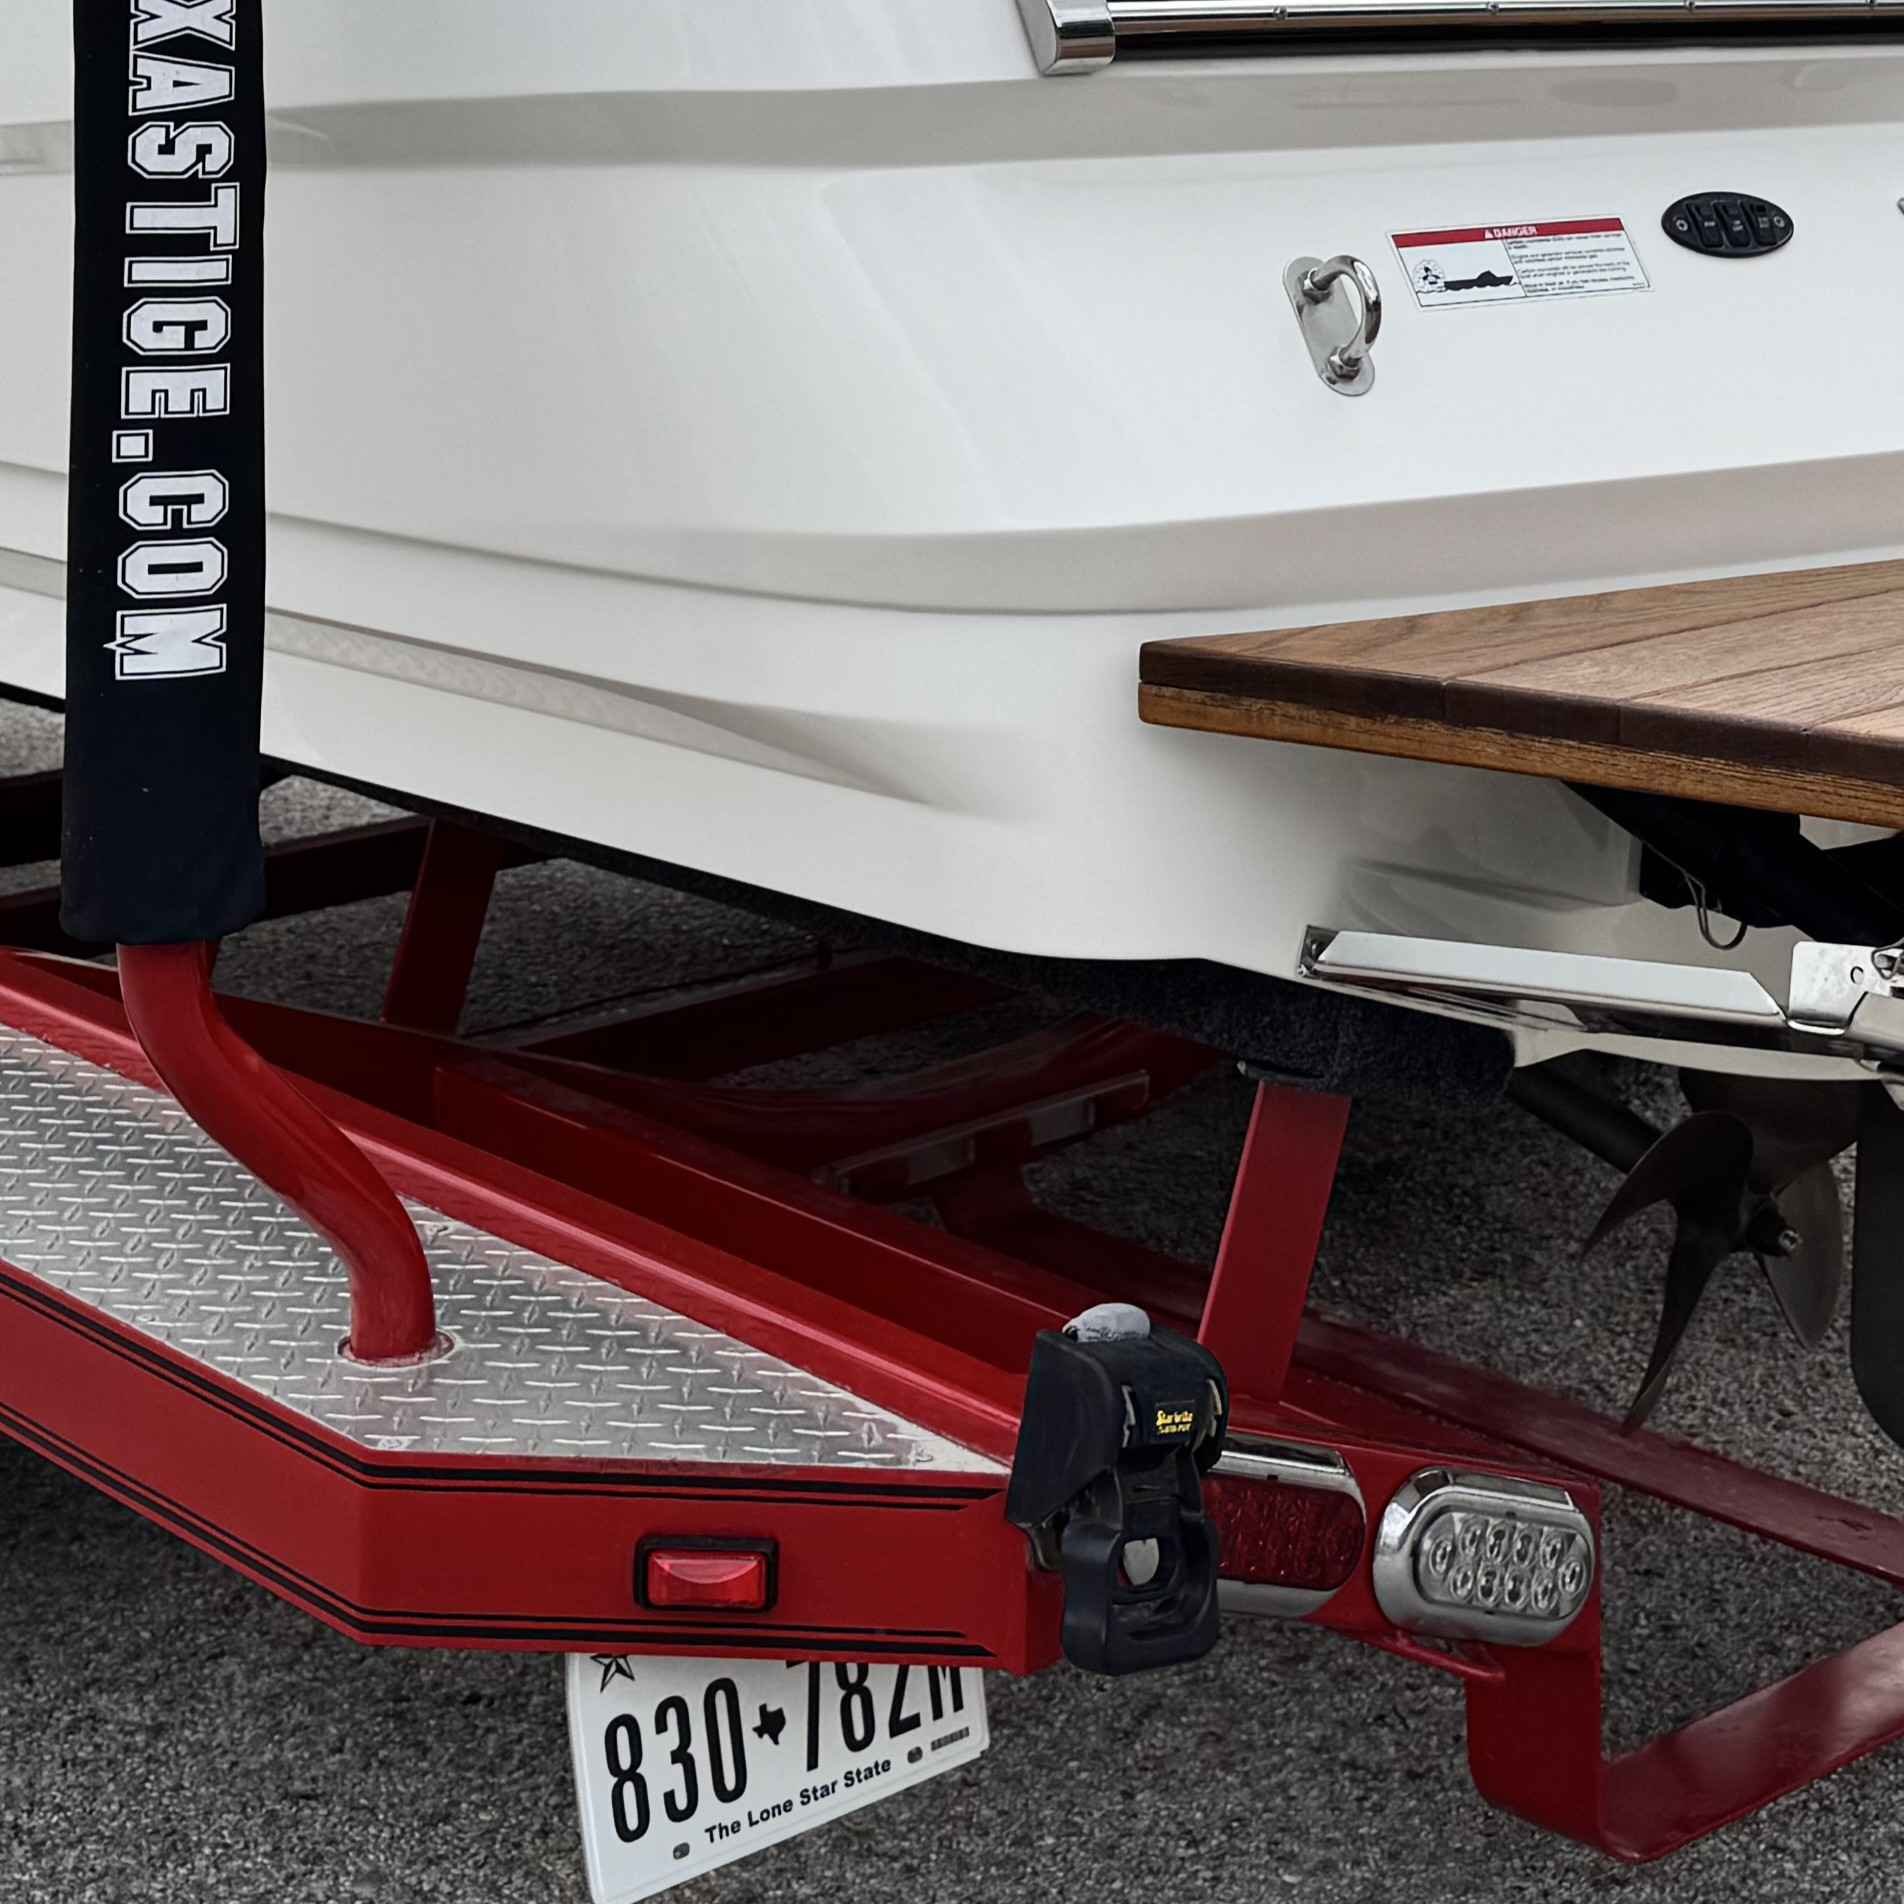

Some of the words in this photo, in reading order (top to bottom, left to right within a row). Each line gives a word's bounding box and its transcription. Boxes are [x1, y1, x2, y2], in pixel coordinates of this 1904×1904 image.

[1493, 226, 1537, 238] DANGER
[603, 1676, 748, 1843] 830
[704, 1820, 742, 1844] The
[747, 1799, 794, 1828] Lone
[799, 1779, 838, 1806] Star
[843, 1759, 892, 1788] State
